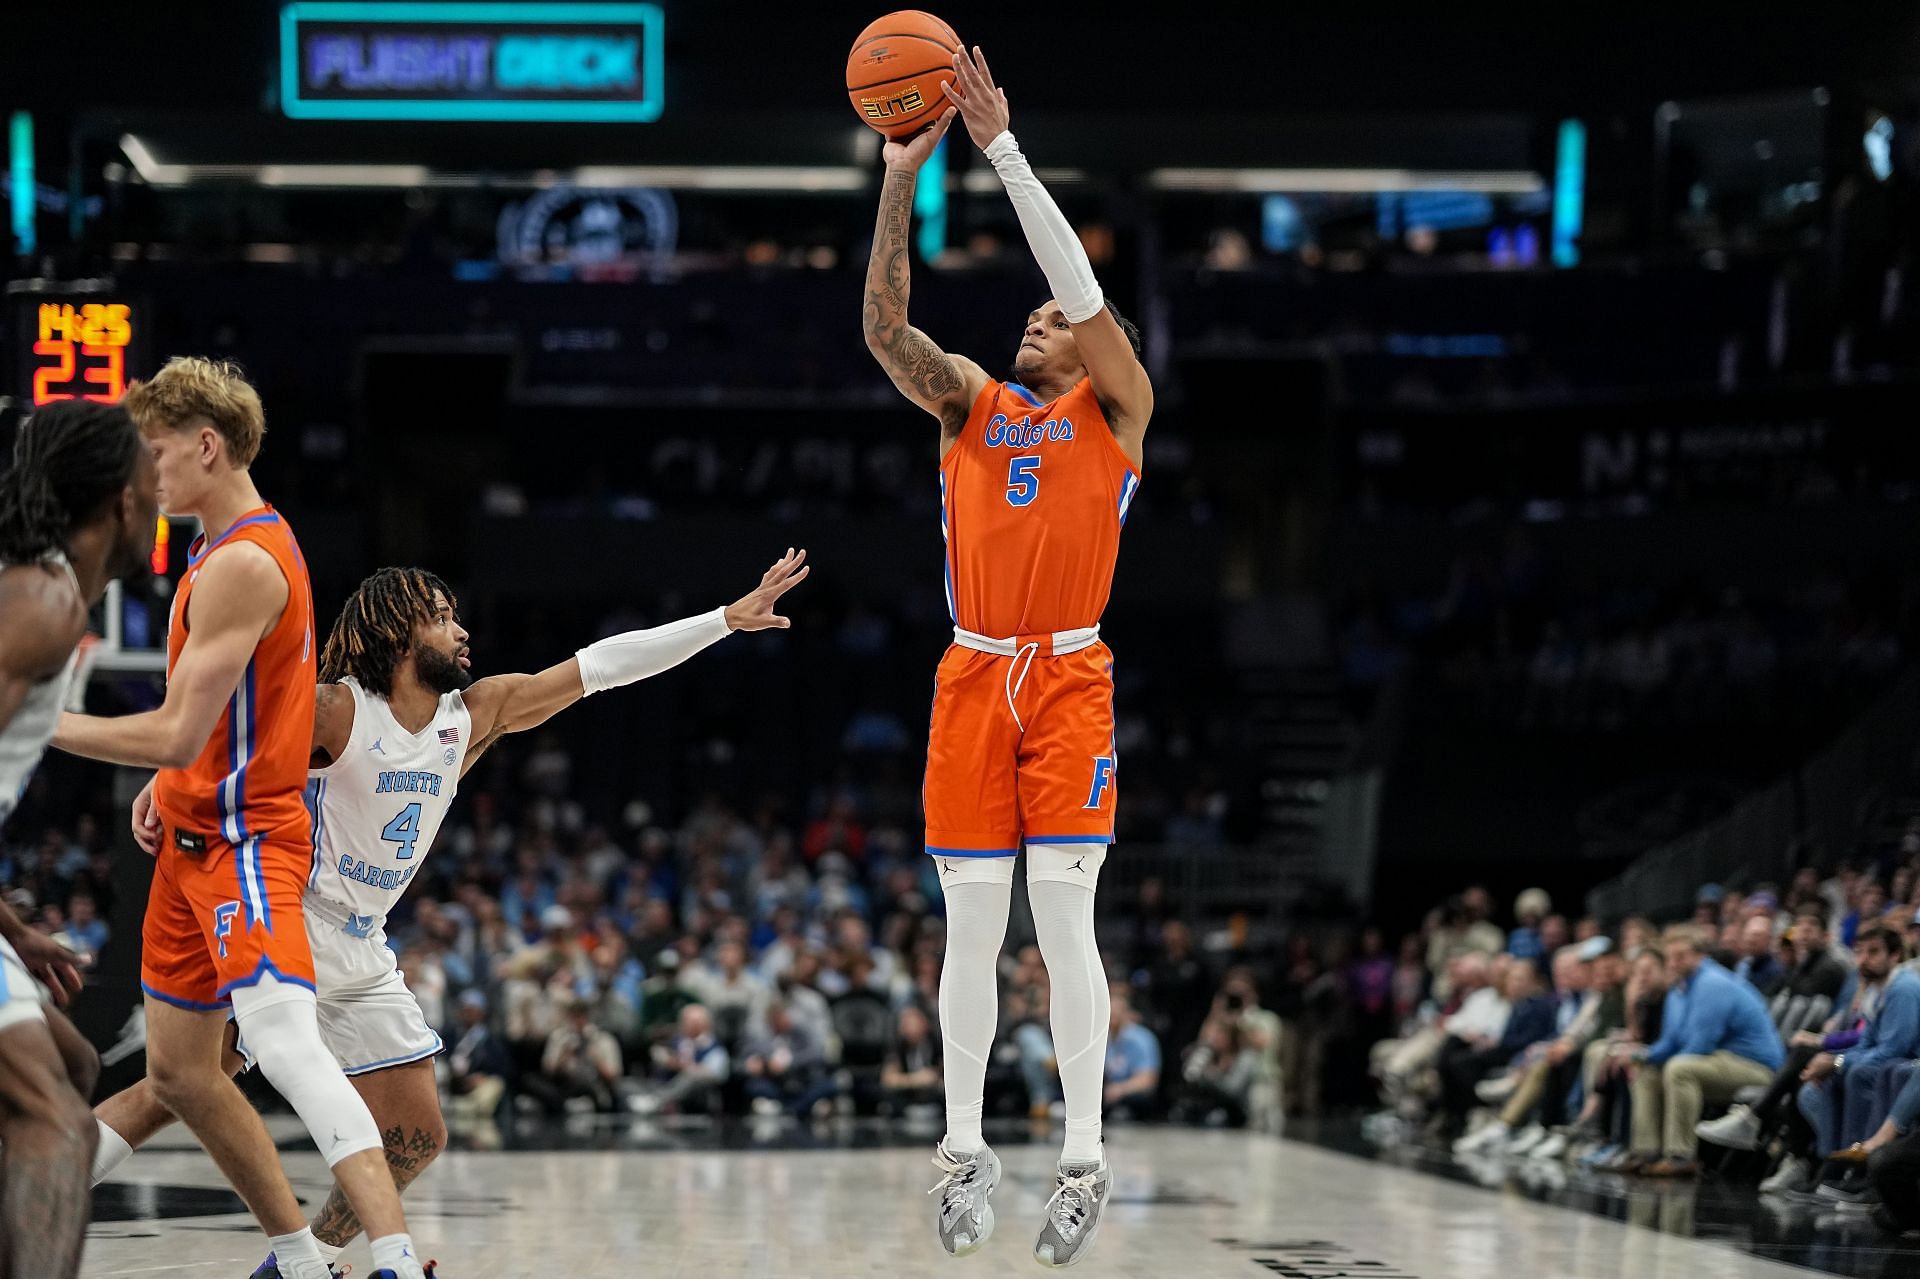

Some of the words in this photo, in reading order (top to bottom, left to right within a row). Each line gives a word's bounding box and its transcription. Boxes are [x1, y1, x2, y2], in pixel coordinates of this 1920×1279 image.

[309, 34, 490, 89] FLIGHT
[495, 34, 639, 89] DECK
[861, 90, 924, 119] ELITE
[33, 340, 124, 406] 23
[984, 413, 1074, 449] Gators
[1005, 455, 1042, 507] 5
[376, 771, 442, 796] NORTH
[1081, 755, 1112, 809] F
[381, 803, 422, 860] 4
[214, 900, 240, 959] F
